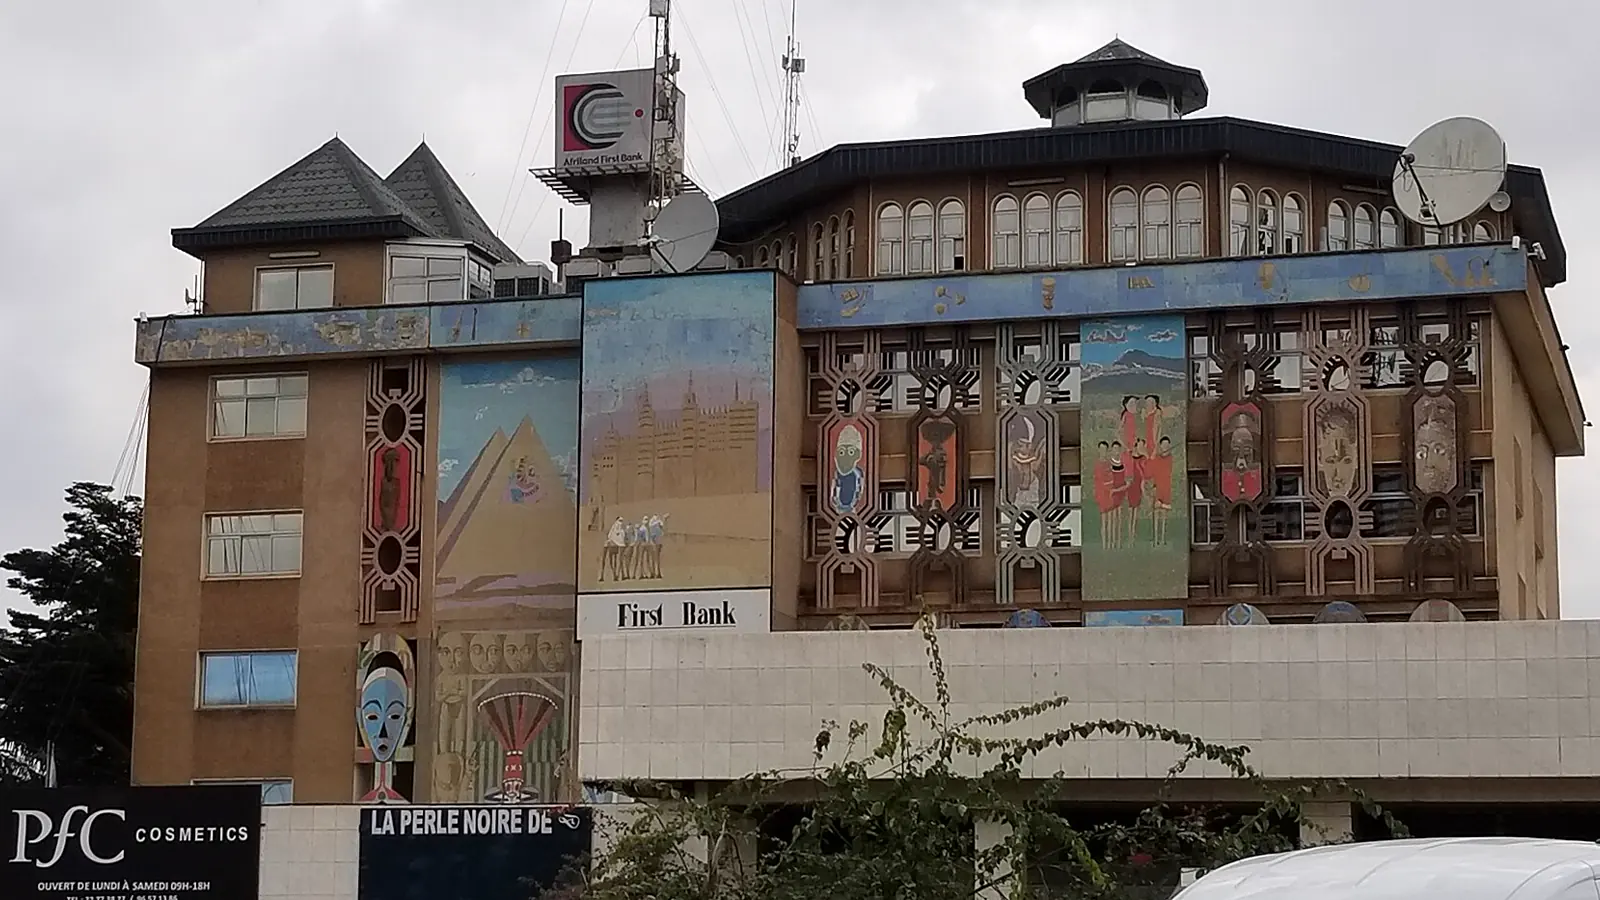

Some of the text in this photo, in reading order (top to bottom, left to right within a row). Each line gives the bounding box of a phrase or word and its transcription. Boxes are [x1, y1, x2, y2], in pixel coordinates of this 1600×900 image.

[563, 152, 643, 166] Afriland First Bank
[617, 601, 736, 627] First Bank
[371, 809, 552, 835] LA PERLE NOIRE DE
[8, 805, 249, 868] PfC COSMETICS
[37, 879, 210, 891] OUVERT DE LUNDI À SAMEDI 09H-18H
